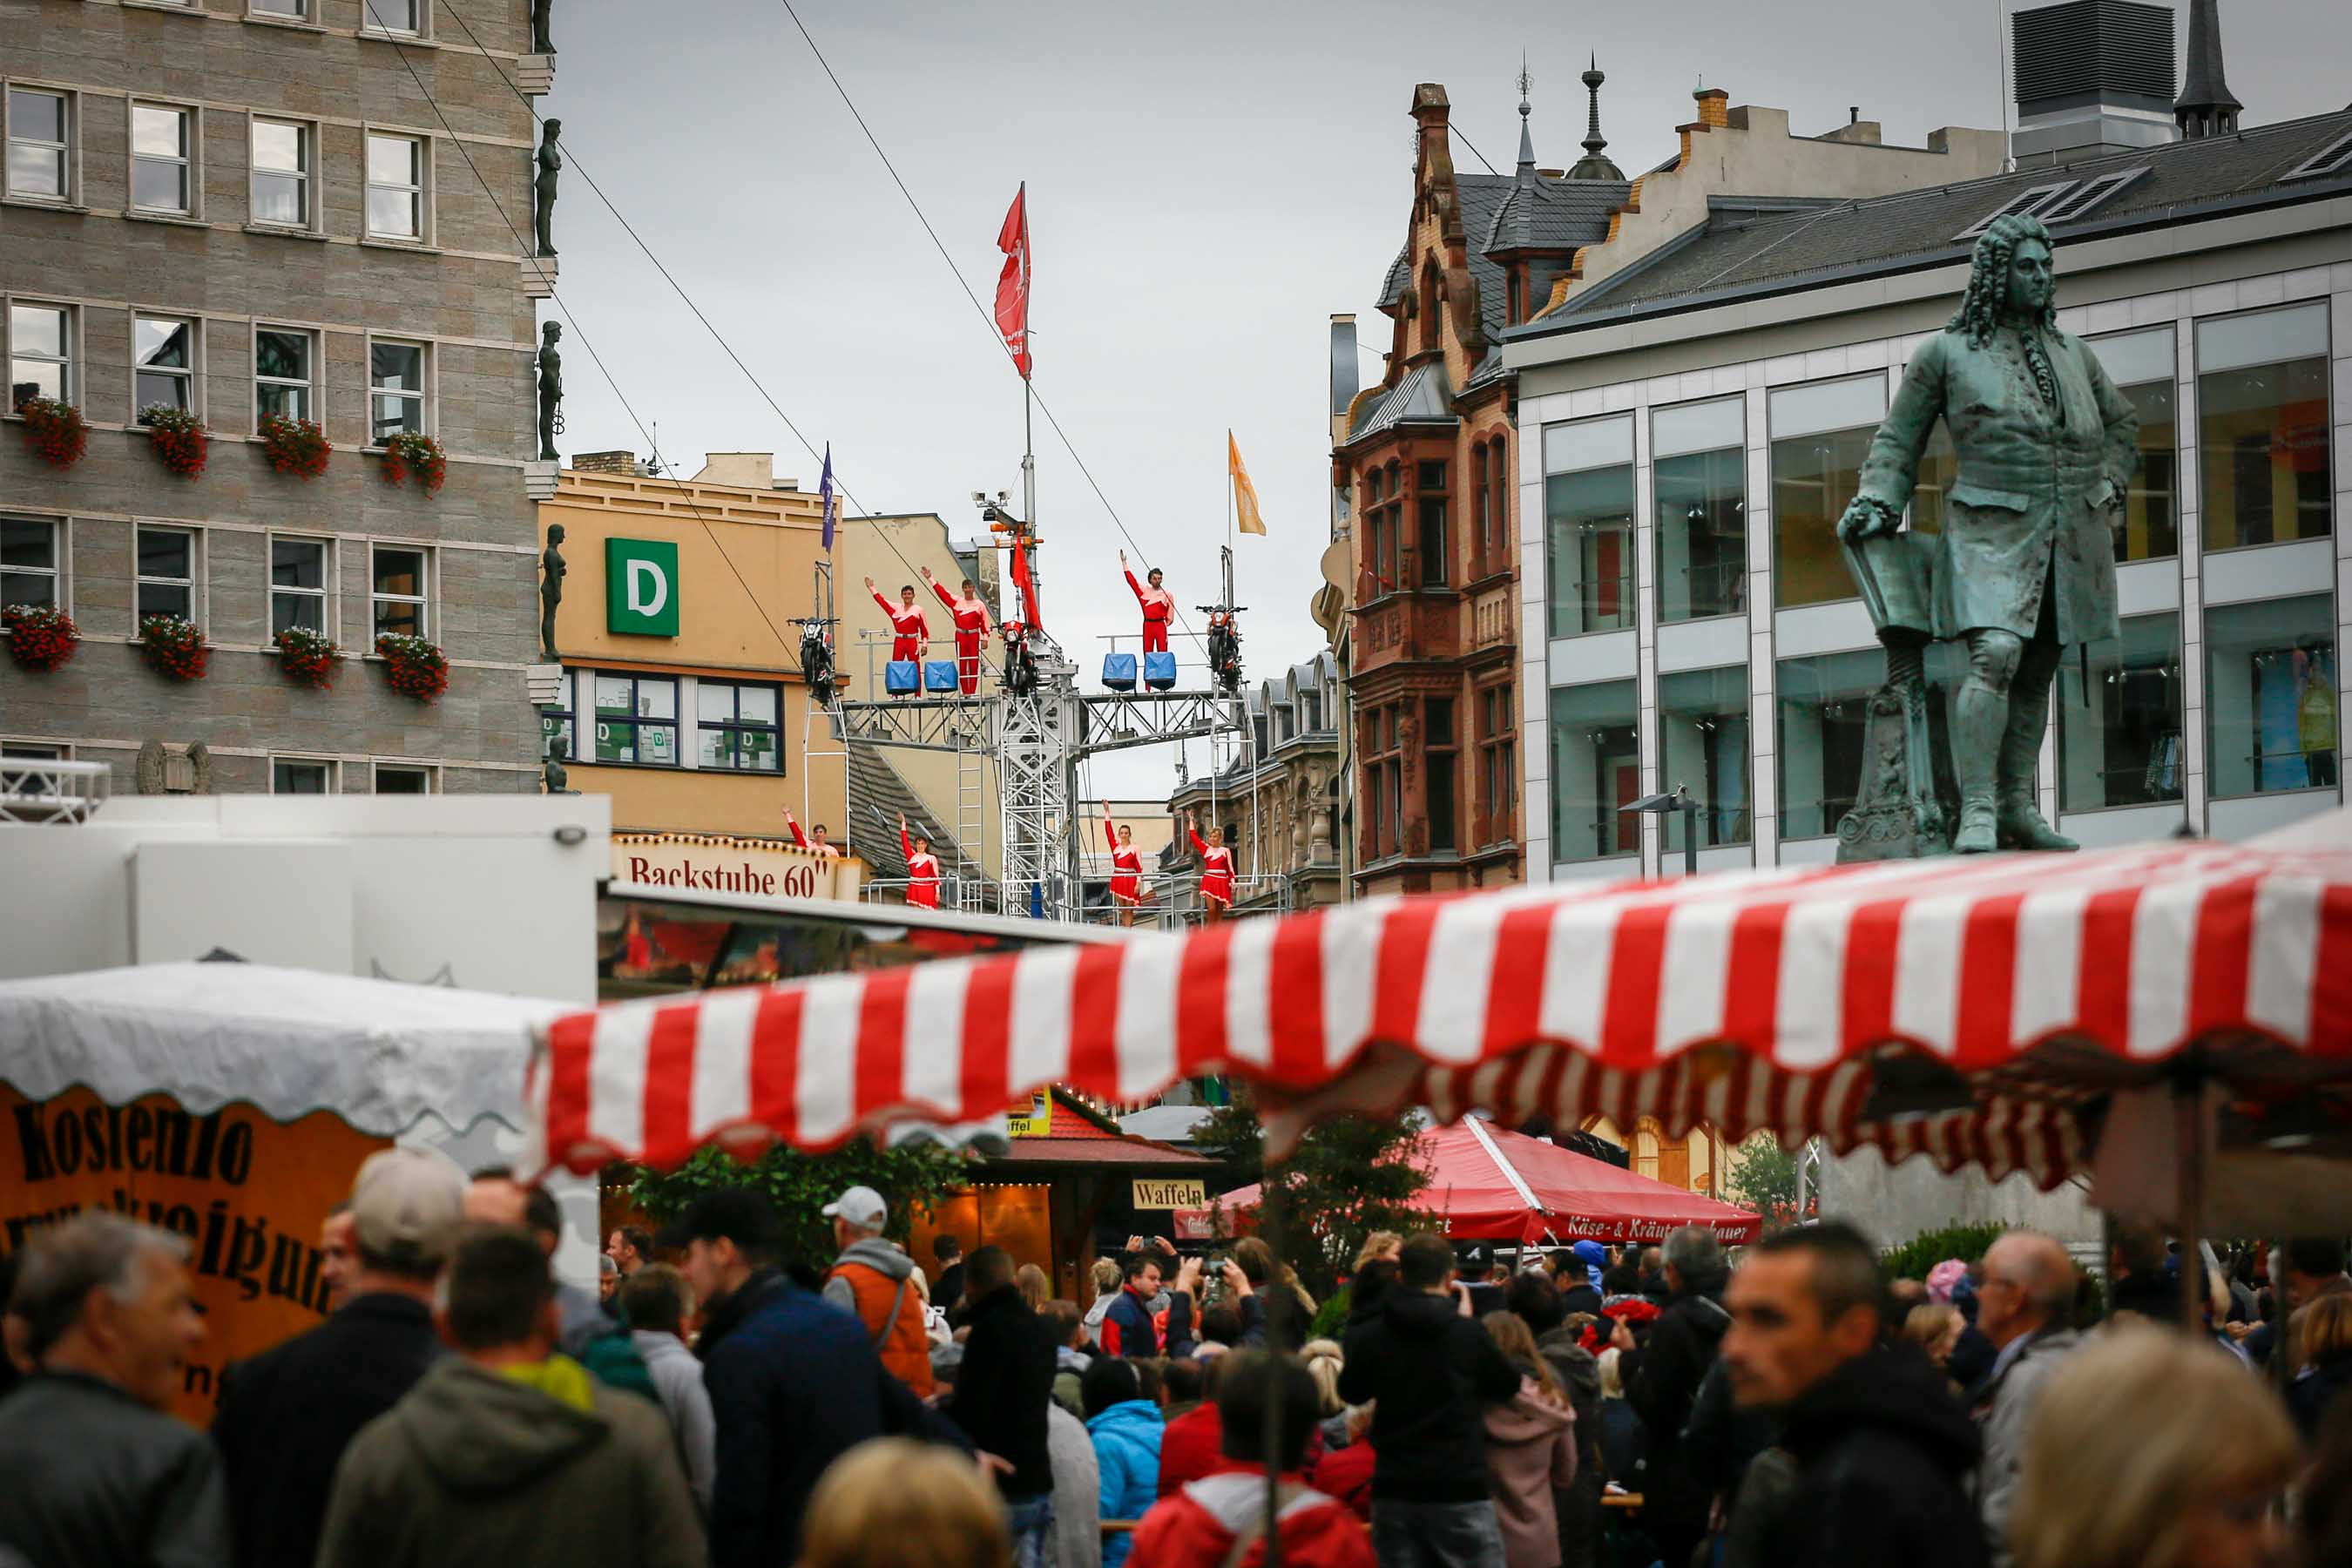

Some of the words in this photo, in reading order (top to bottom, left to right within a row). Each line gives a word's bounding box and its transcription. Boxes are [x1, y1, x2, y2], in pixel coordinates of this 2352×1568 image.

[626, 558, 667, 617] D
[543, 718, 552, 730] D
[598, 723, 610, 740] D
[654, 734, 663, 745] D
[741, 732, 754, 747] D
[629, 857, 775, 896] Backstube
[1136, 1183, 1202, 1205] Waffeln
[1568, 1215, 1611, 1236] Käse-
[1613, 1220, 1624, 1238] &
